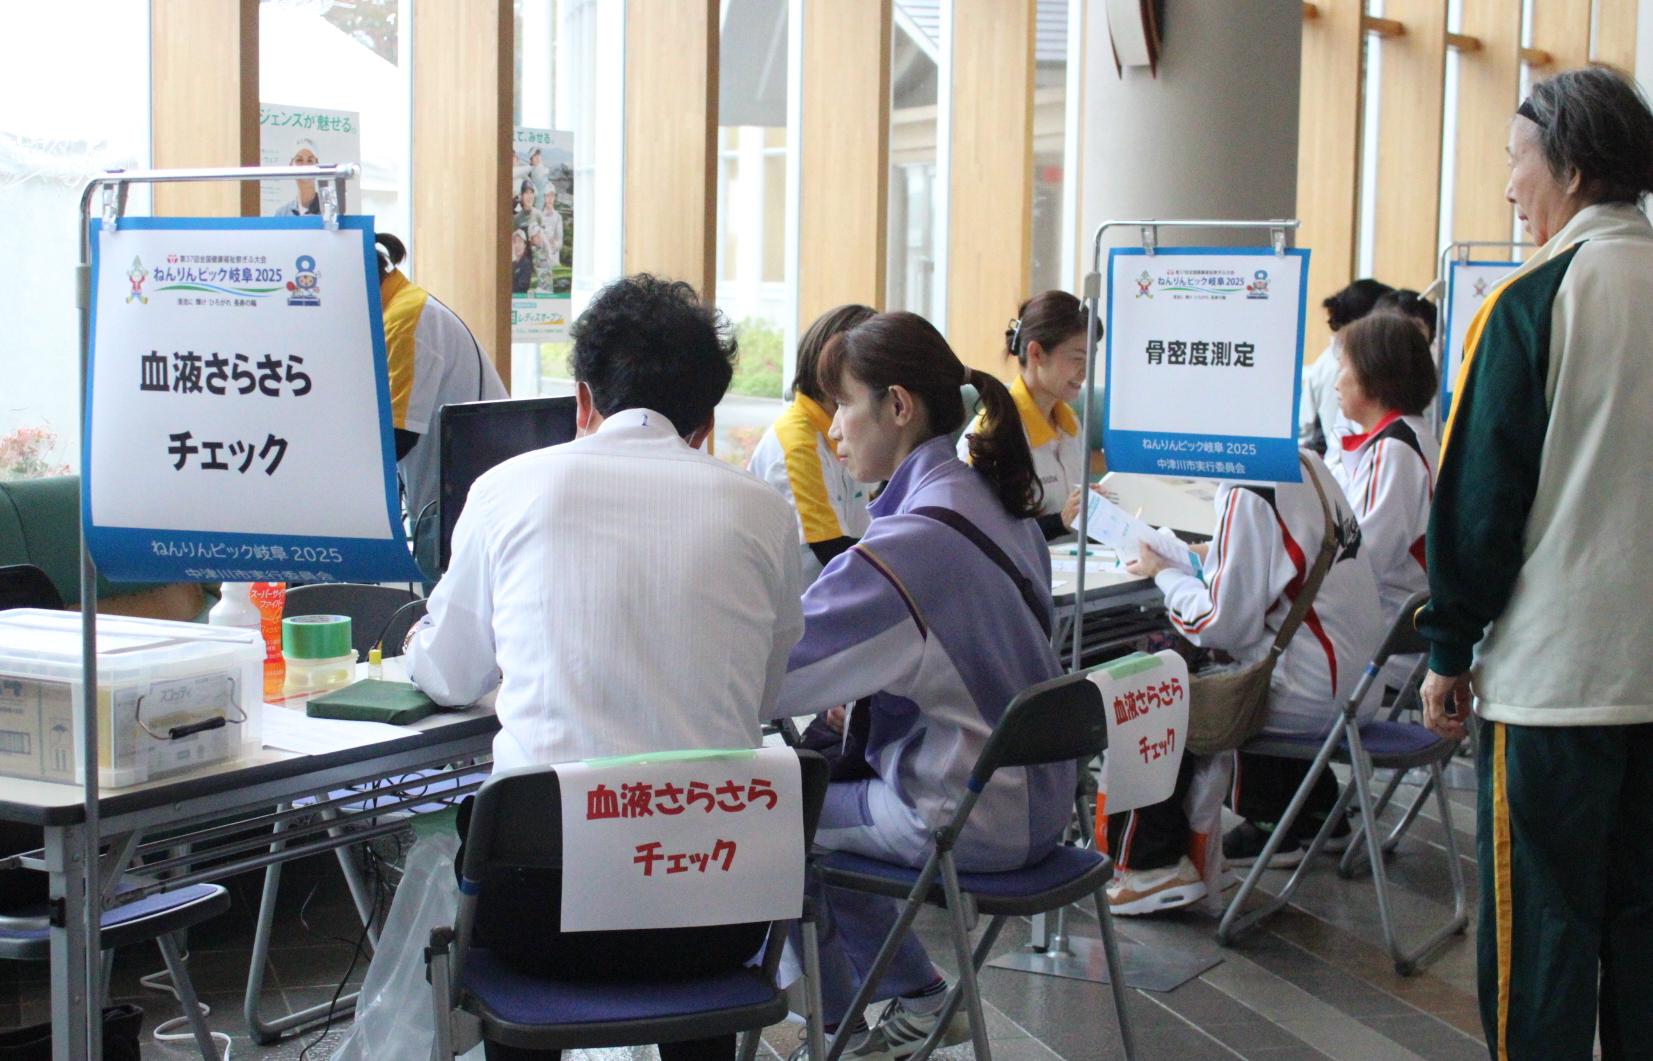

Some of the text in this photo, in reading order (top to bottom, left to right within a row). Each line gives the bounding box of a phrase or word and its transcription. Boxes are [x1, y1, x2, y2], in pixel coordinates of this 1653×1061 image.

[513, 131, 556, 145] て、みせる。
[153, 266, 282, 283] ねんりんピック岐阜 2025
[1226, 277, 1245, 286] 2025
[1146, 340, 1255, 368] 骨密度測定
[140, 350, 312, 397] 血液さらさら
[167, 430, 289, 476] チェック
[1142, 437, 1257, 455] ねんりんピック岐阜 2025
[1157, 458, 1246, 475] 中津川市実行委員会
[151, 540, 343, 563] ねんりんピック岐阜 2025
[1113, 677, 1184, 726] 血液さらさら
[1138, 727, 1176, 764] チェック
[586, 778, 778, 821] 血液さらさら
[633, 838, 737, 877] チェック
